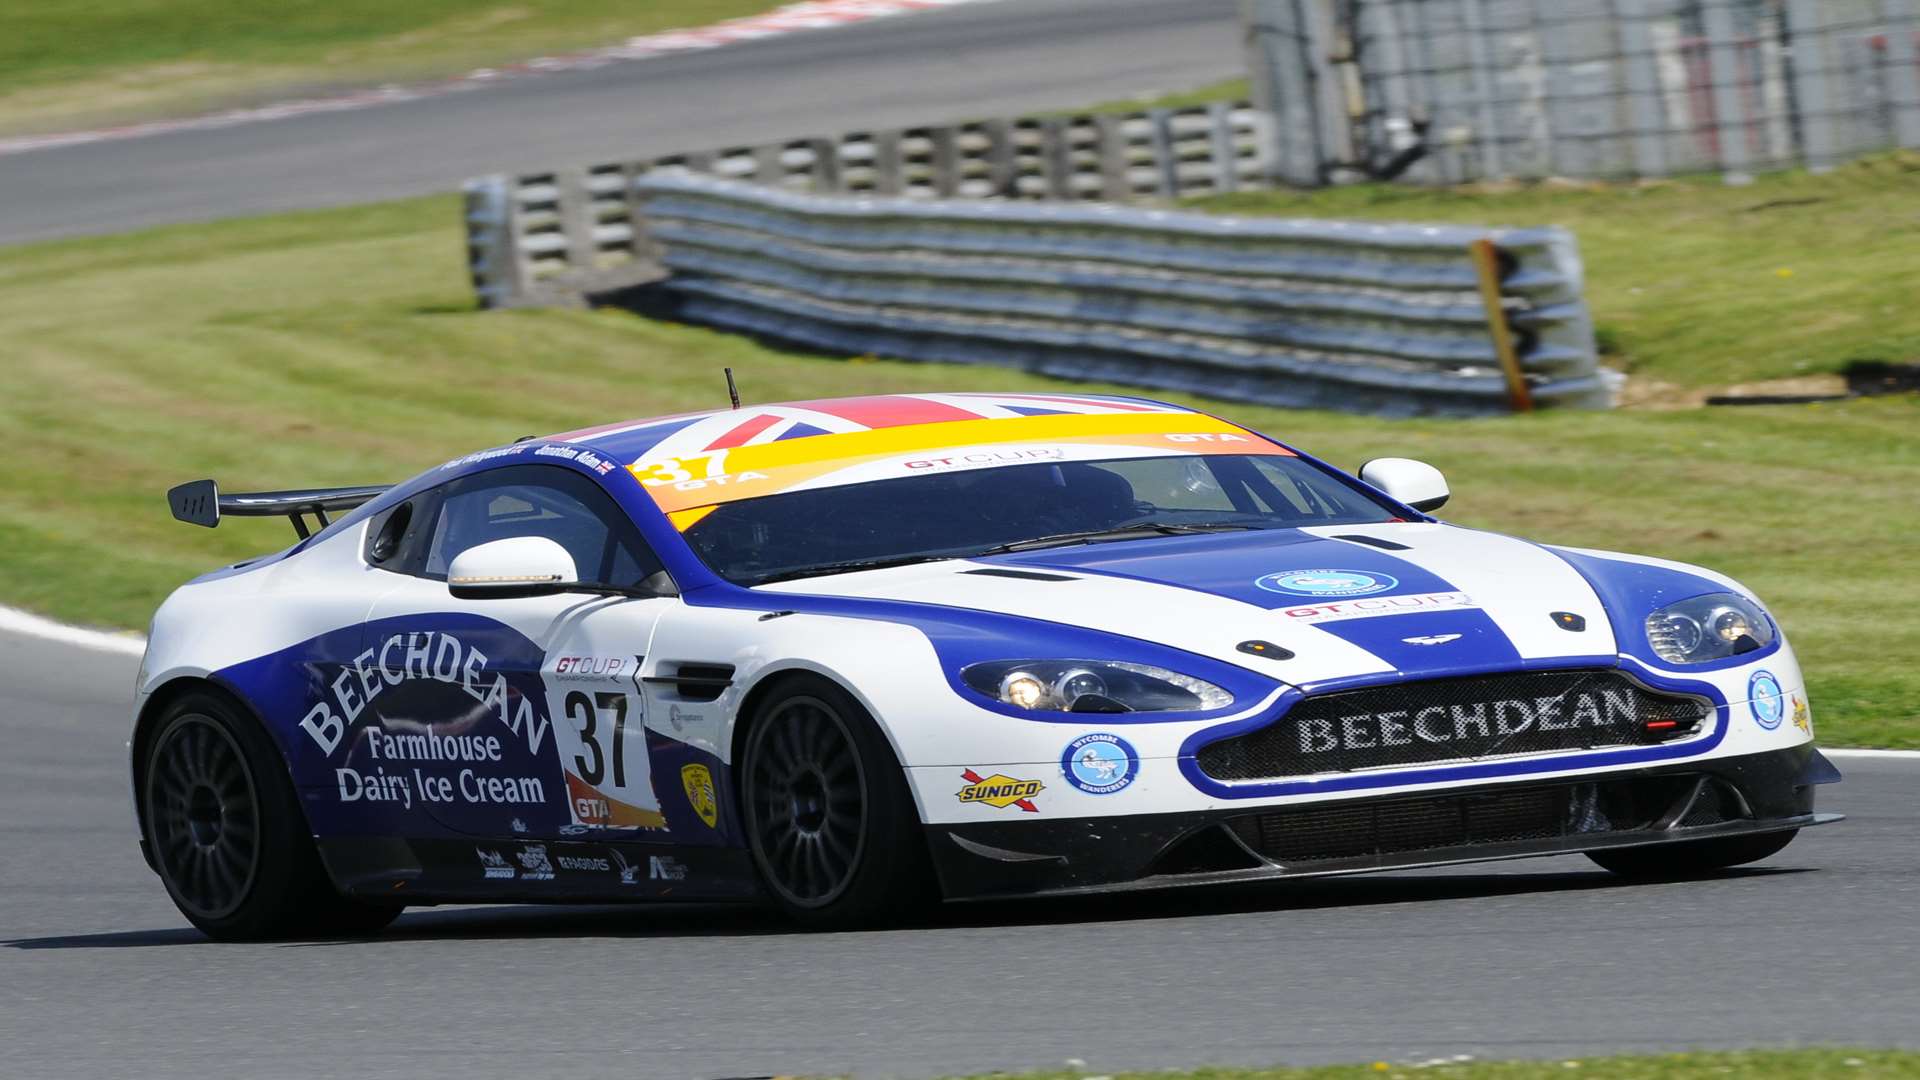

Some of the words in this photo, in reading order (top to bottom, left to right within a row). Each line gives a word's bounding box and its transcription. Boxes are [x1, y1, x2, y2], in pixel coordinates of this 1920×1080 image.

[1164, 433, 1248, 442] GTA
[633, 448, 730, 487] 37
[674, 471, 769, 491] GTA
[298, 631, 549, 757] BEECHDEAN
[1298, 688, 1639, 753] BEECHDEAN
[365, 724, 502, 761] Farmhouse
[565, 690, 628, 788] 37
[1072, 734, 1119, 749] WYCOMBE
[335, 766, 411, 809] Dairy
[414, 768, 454, 802] Ice
[459, 769, 546, 803] Cream
[963, 782, 1039, 800] SUNOCO
[1079, 778, 1130, 793] WANDERERS
[577, 798, 610, 819] GTA
